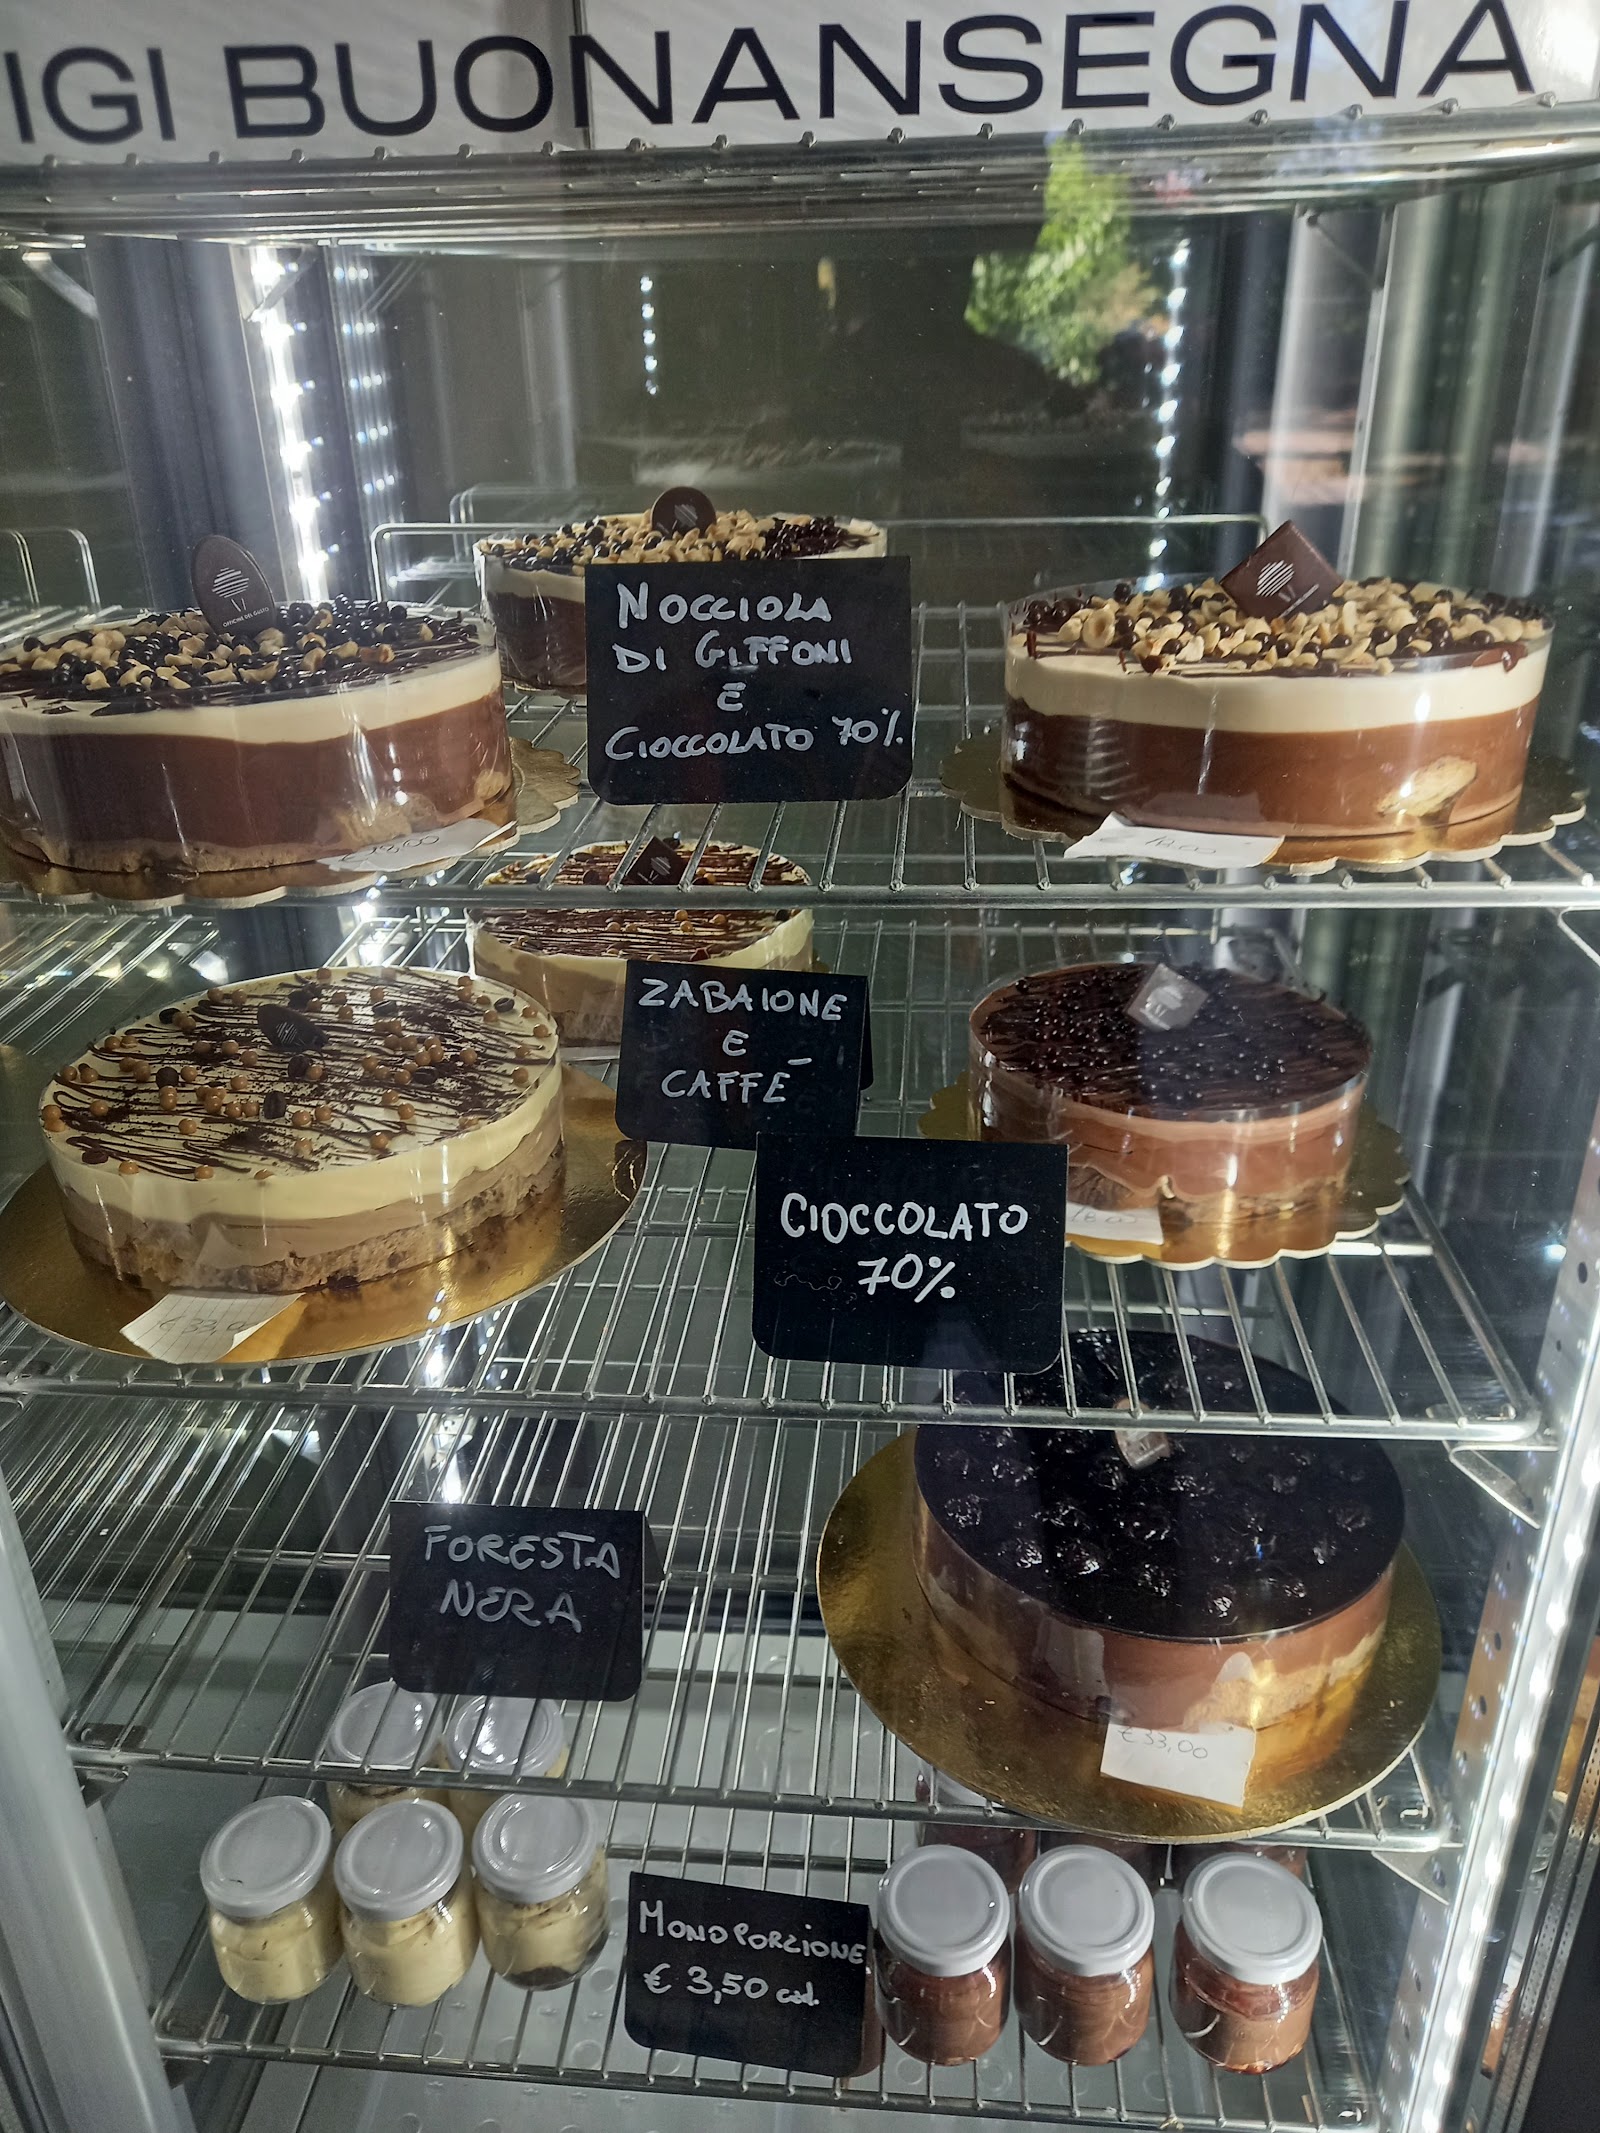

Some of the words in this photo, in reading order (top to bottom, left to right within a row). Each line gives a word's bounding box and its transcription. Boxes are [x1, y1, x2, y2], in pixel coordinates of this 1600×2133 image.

[223, 0, 1536, 139] BUONANSEGNA
[617, 581, 832, 629] NOCCIOLA
[612, 643, 666, 673] DI
[717, 682, 746, 711] E
[605, 725, 814, 760] CIOCCOLATO
[831, 707, 904, 746] 70%
[638, 978, 847, 1021] ZABAIONE
[722, 1030, 749, 1056] E
[780, 1192, 1029, 1244] CIOCCOLATO
[857, 1253, 956, 1303] 70%
[424, 1524, 621, 1579] FORESTA
[440, 1578, 583, 1634] NERA
[643, 1962, 672, 1994] €
[686, 1965, 769, 2005] 3,50
